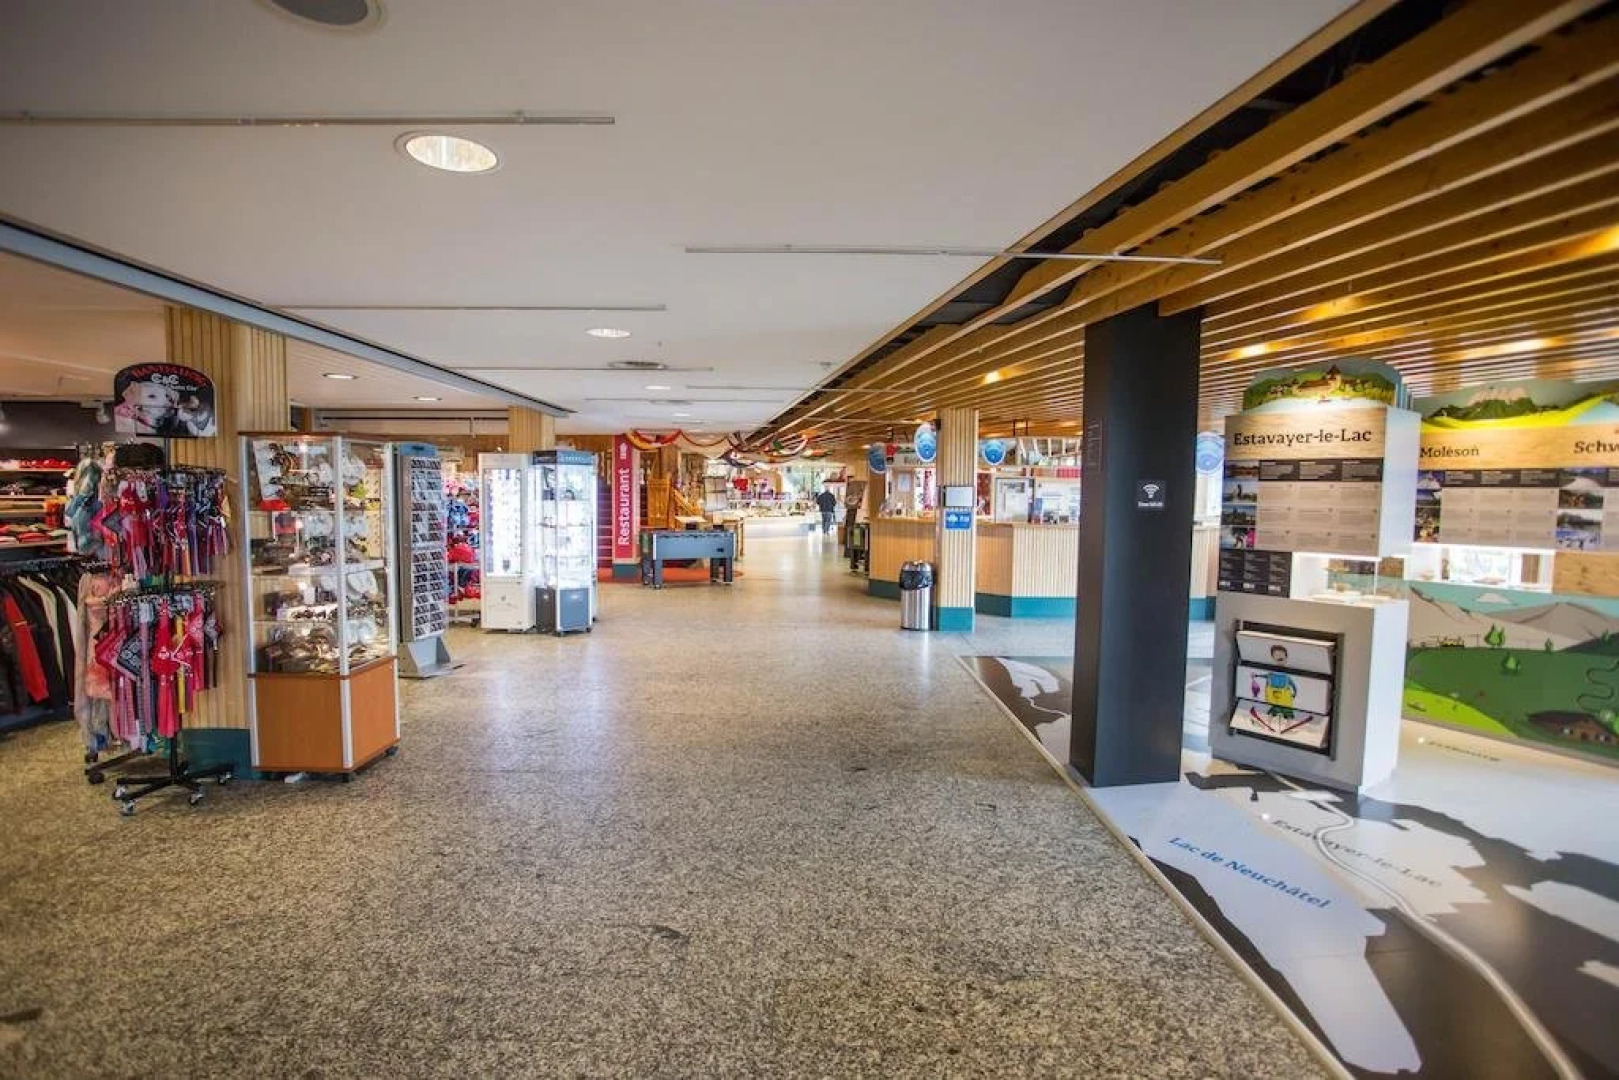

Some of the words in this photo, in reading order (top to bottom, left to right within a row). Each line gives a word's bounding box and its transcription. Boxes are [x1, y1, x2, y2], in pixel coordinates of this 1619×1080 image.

[1234, 428, 1373, 447] Estavayer-le-Lac
[618, 467, 630, 545] Restaurant
[1168, 837, 1200, 853] Lac
[1200, 850, 1224, 863] de
[1225, 860, 1332, 908] Neuchâtel
